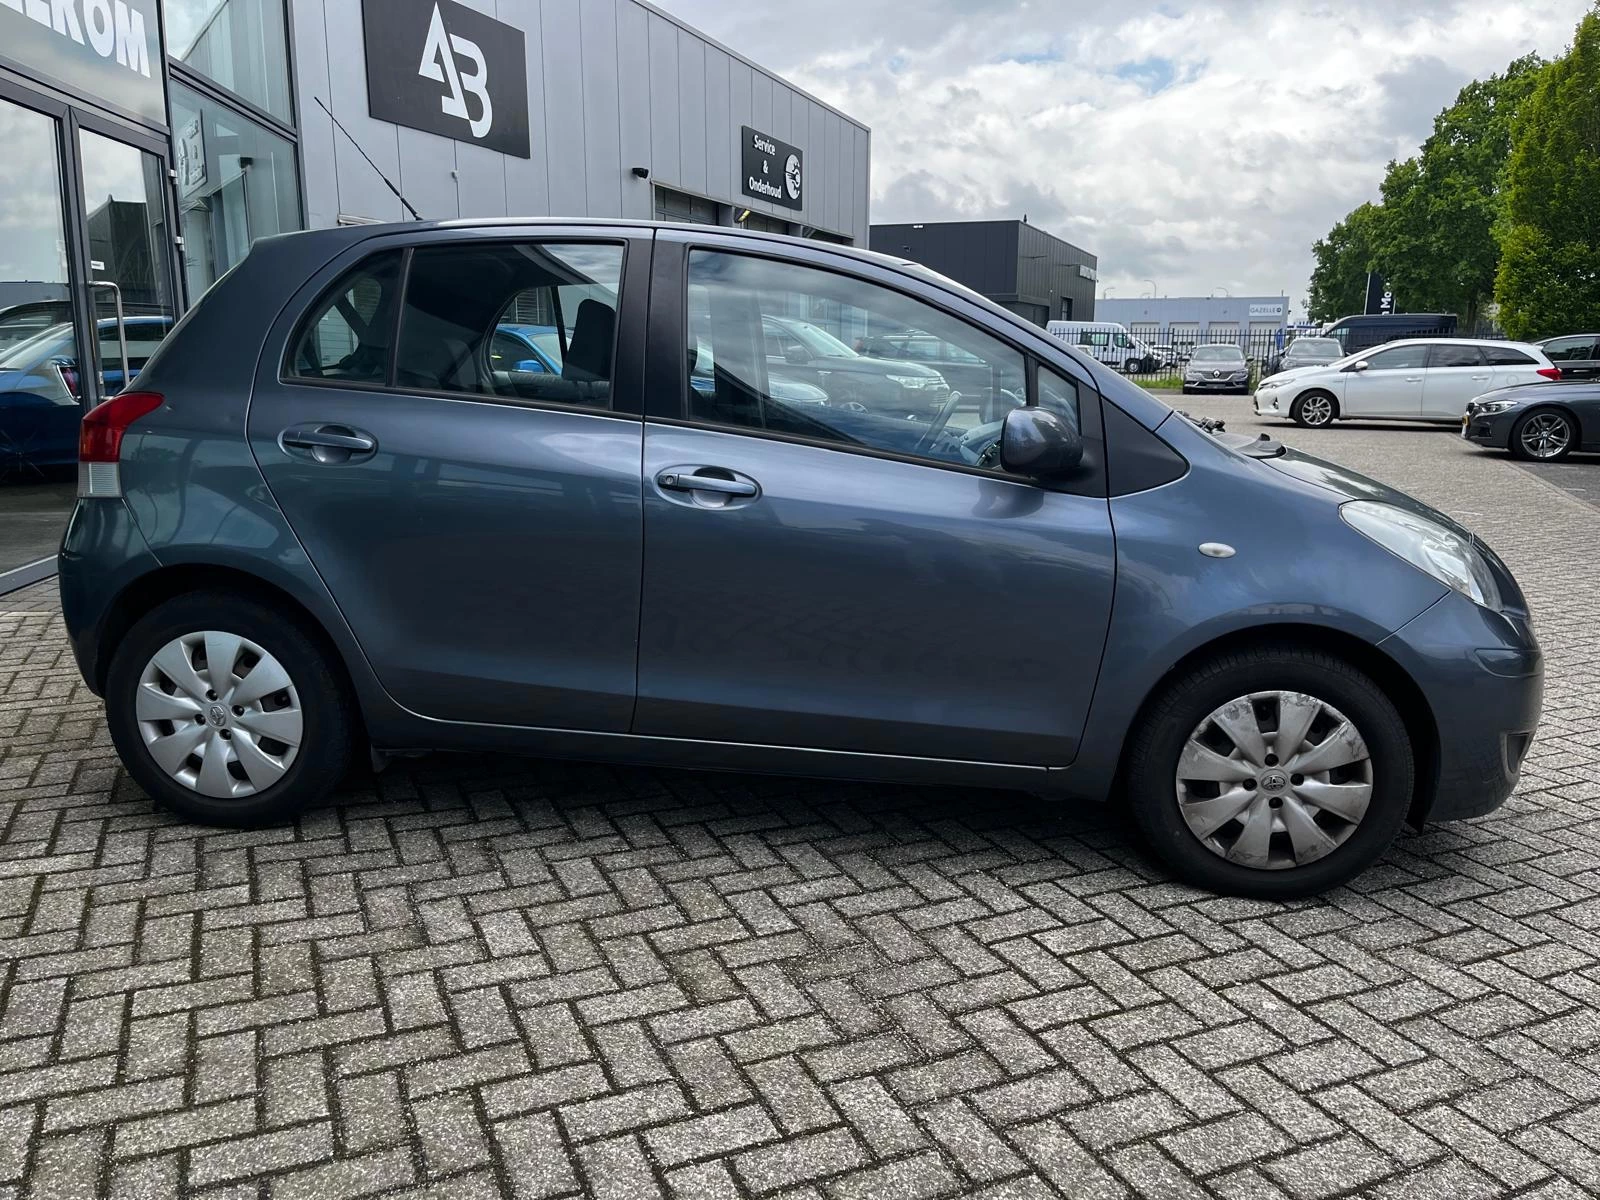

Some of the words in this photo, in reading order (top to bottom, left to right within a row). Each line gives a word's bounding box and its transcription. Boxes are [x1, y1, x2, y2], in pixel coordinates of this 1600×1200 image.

[0, 0, 151, 78] KOM
[754, 134, 776, 156] Service
[762, 159, 769, 174] &
[748, 176, 782, 199] Onderhoud
